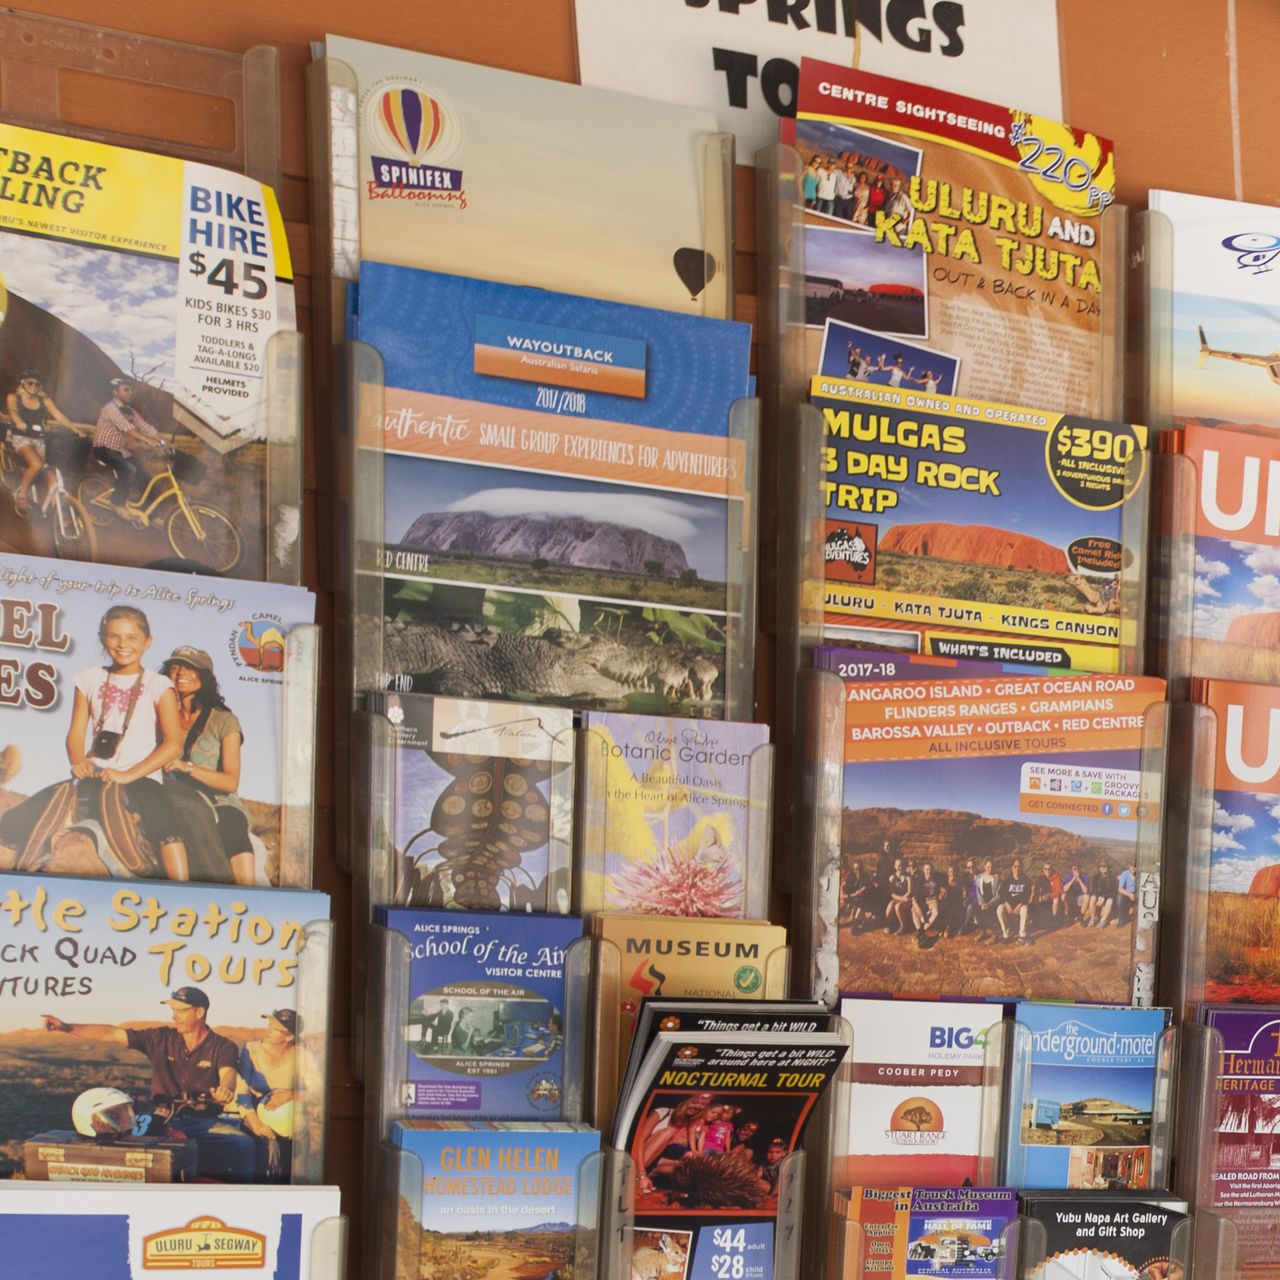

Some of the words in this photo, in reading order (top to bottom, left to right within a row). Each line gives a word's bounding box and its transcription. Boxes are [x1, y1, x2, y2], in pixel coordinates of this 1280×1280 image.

[684, 0, 965, 57] RINGS
[818, 82, 889, 110] CENTRE
[895, 100, 1006, 139] SIGHTSEEING
[1008, 121, 1093, 189] $220
[380, 164, 452, 189] SPINIFEX
[189, 184, 265, 227] BIKE
[908, 175, 1044, 239] ULURU
[1046, 215, 1096, 247] AND
[69, 228, 108, 241] VISITOR
[110, 234, 167, 251] EXPERIENCE
[188, 217, 268, 258] HIRE
[873, 209, 982, 265] KATA
[995, 236, 1102, 294] TJUTA
[188, 250, 268, 300] $45
[185, 297, 213, 312] KIDS
[216, 301, 248, 317] BIKES
[251, 306, 271, 321] $30
[506, 335, 614, 363] WAYOUTBACK
[201, 385, 249, 399] PROVIDED
[205, 375, 247, 388] HELMETS
[536, 387, 586, 414] 2017/2018
[906, 393, 951, 412] OWNED
[480, 423, 517, 451] SMALL
[520, 428, 560, 454] GROUP
[564, 433, 635, 467] EXPERIENCES
[821, 407, 967, 454] MULGAS
[1056, 425, 1135, 463] $390
[846, 449, 909, 482] DAY
[916, 460, 1002, 496] ROCK
[819, 480, 898, 513] TRIP
[143, 585, 181, 601] Alice
[183, 587, 235, 611] Springs
[251, 612, 283, 625] CAMEL
[1001, 613, 1050, 630] KINGS
[1055, 620, 1119, 638] CANYON
[938, 641, 990, 659] WHAT'S
[993, 646, 1063, 664] INCLUDED
[838, 663, 896, 678] 2017-18
[929, 684, 982, 698] ISLAND
[994, 682, 1040, 697] GREAT
[1043, 681, 1094, 695] OCEAN
[1096, 679, 1135, 694] ROAD
[885, 705, 956, 720] FLINDERS
[959, 702, 1018, 717] RANGES
[1029, 698, 1114, 714] GRAMPIANS
[852, 725, 921, 741] BAROSSA
[924, 723, 974, 739] VALLEY
[985, 720, 1051, 736] OUTBACK
[1062, 717, 1090, 732] RED
[1092, 715, 1145, 730] CENTRE
[1024, 737, 1066, 749] TOURS
[107, 888, 307, 953] Station
[414, 924, 440, 933] ALICE
[442, 925, 481, 935] SPRINGS
[405, 935, 473, 962] School
[473, 939, 499, 964] of
[498, 944, 527, 966] the
[532, 945, 567, 967] Air
[625, 938, 759, 959] MUSEUM
[148, 941, 299, 988] Tours
[485, 968, 523, 978] VISITOR
[525, 968, 562, 979] CENTRE
[929, 1025, 988, 1050] BIG4
[806, 1049, 835, 1059] WILD
[659, 1071, 768, 1088] NOCTURNAL
[775, 1073, 826, 1088] TOUR
[878, 1067, 925, 1077] COOBER
[930, 1067, 960, 1078] PEDY
[1216, 1079, 1275, 1092] HERITAGE
[440, 1146, 491, 1172] GLEN
[499, 1146, 559, 1172] HELEN
[423, 1176, 517, 1196] HOMESTEAD
[522, 1176, 574, 1196] LODGE
[863, 1188, 913, 1202] Biggest
[914, 1188, 953, 1201] Truck
[956, 1189, 1012, 1201] Museum
[894, 1200, 909, 1212] in
[911, 1200, 979, 1212] Australia
[1055, 1212, 1083, 1224] Yubu
[1085, 1212, 1111, 1225] Napa
[1113, 1212, 1129, 1224] Art
[1132, 1213, 1168, 1227] Gallery
[713, 1228, 746, 1252] $44
[1076, 1226, 1092, 1237] and
[1095, 1226, 1118, 1237] Gift
[1120, 1226, 1145, 1239] Shop
[155, 1238, 193, 1253] ULURU
[213, 1238, 258, 1252] SEGWAY
[711, 1254, 744, 1279] $28
